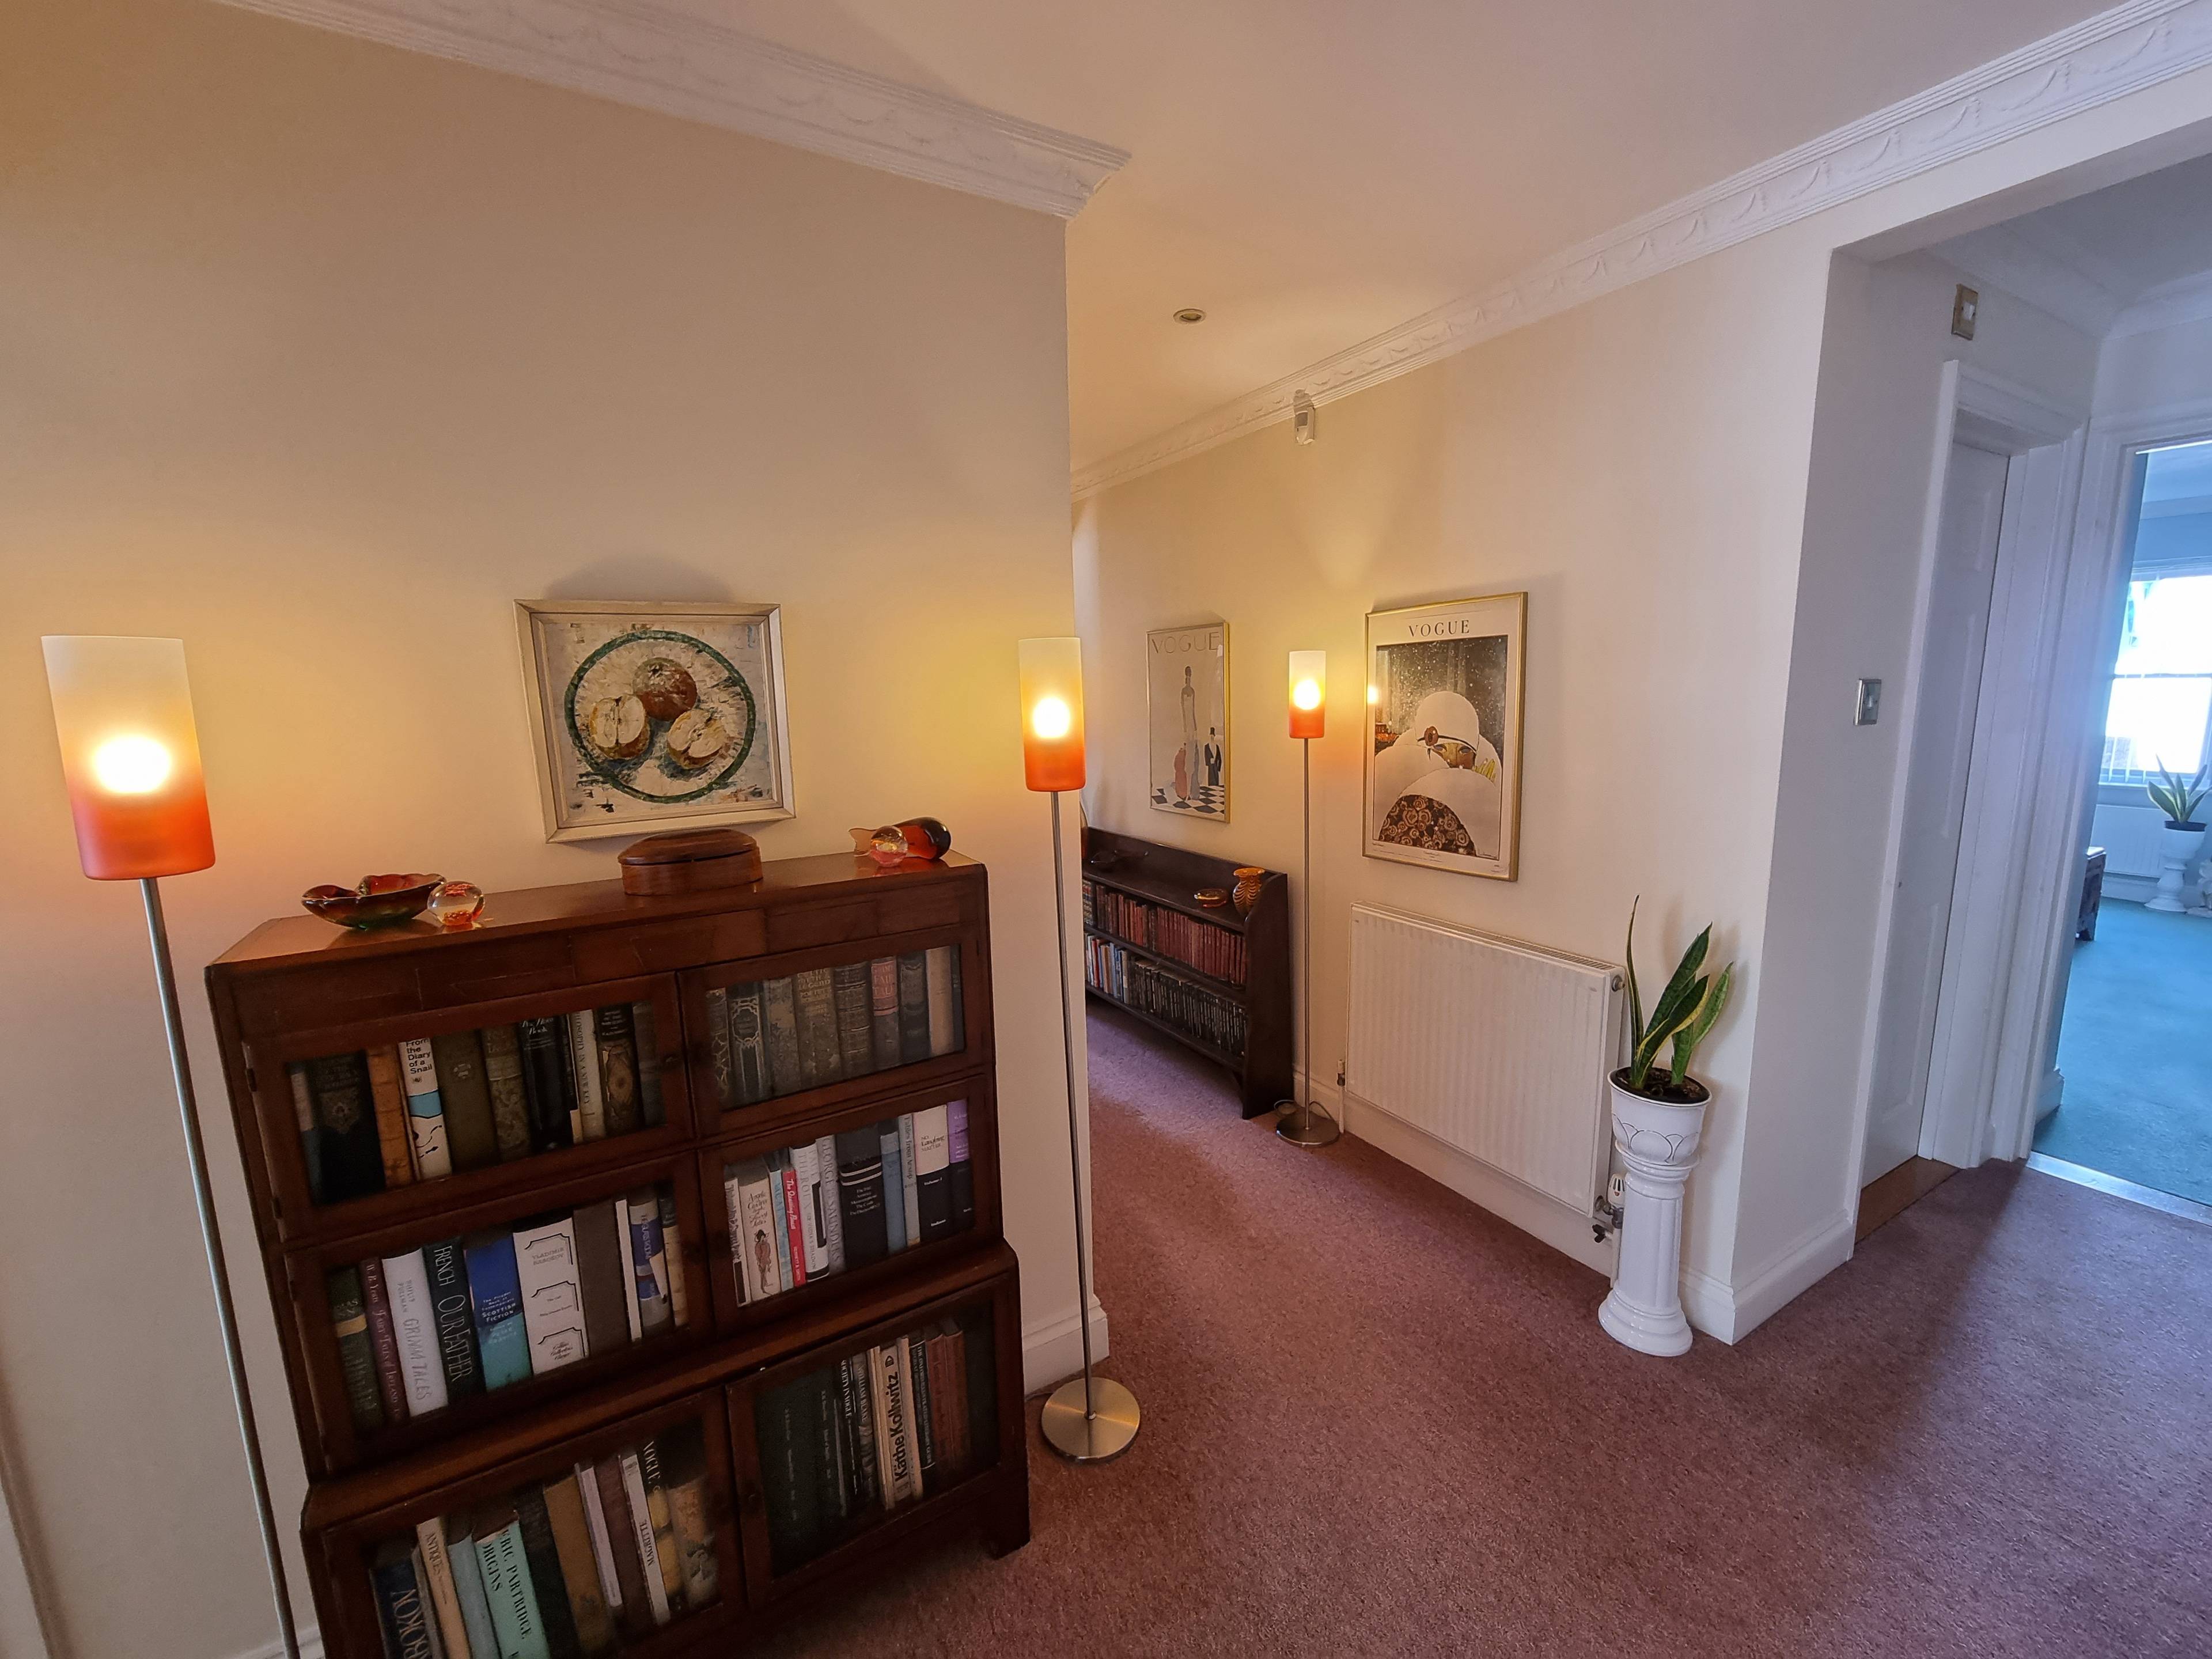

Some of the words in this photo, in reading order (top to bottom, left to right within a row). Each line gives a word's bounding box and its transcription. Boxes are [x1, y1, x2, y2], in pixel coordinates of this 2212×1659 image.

[1152, 631, 1220, 654] VOGUE
[1408, 619, 1470, 637] VOGUE
[406, 1039, 430, 1047] From
[408, 1051, 431, 1060] Diary
[410, 1065, 433, 1074] Snail
[433, 1245, 457, 1286] FRENCH
[532, 1247, 564, 1260] VLADIMIR
[438, 1294, 465, 1335] OUR
[481, 1302, 517, 1319] SCOTTISH
[486, 1309, 514, 1323] FICTION
[403, 1318, 426, 1360] GRIMM
[444, 1328, 474, 1382] FATHER
[411, 1363, 432, 1400] TALES
[885, 1371, 903, 1438] Kollwitz
[893, 1435, 908, 1482] Käthe
[639, 1519, 656, 1566] MAGRITTE
[506, 1564, 532, 1639] PARTRIDGE
